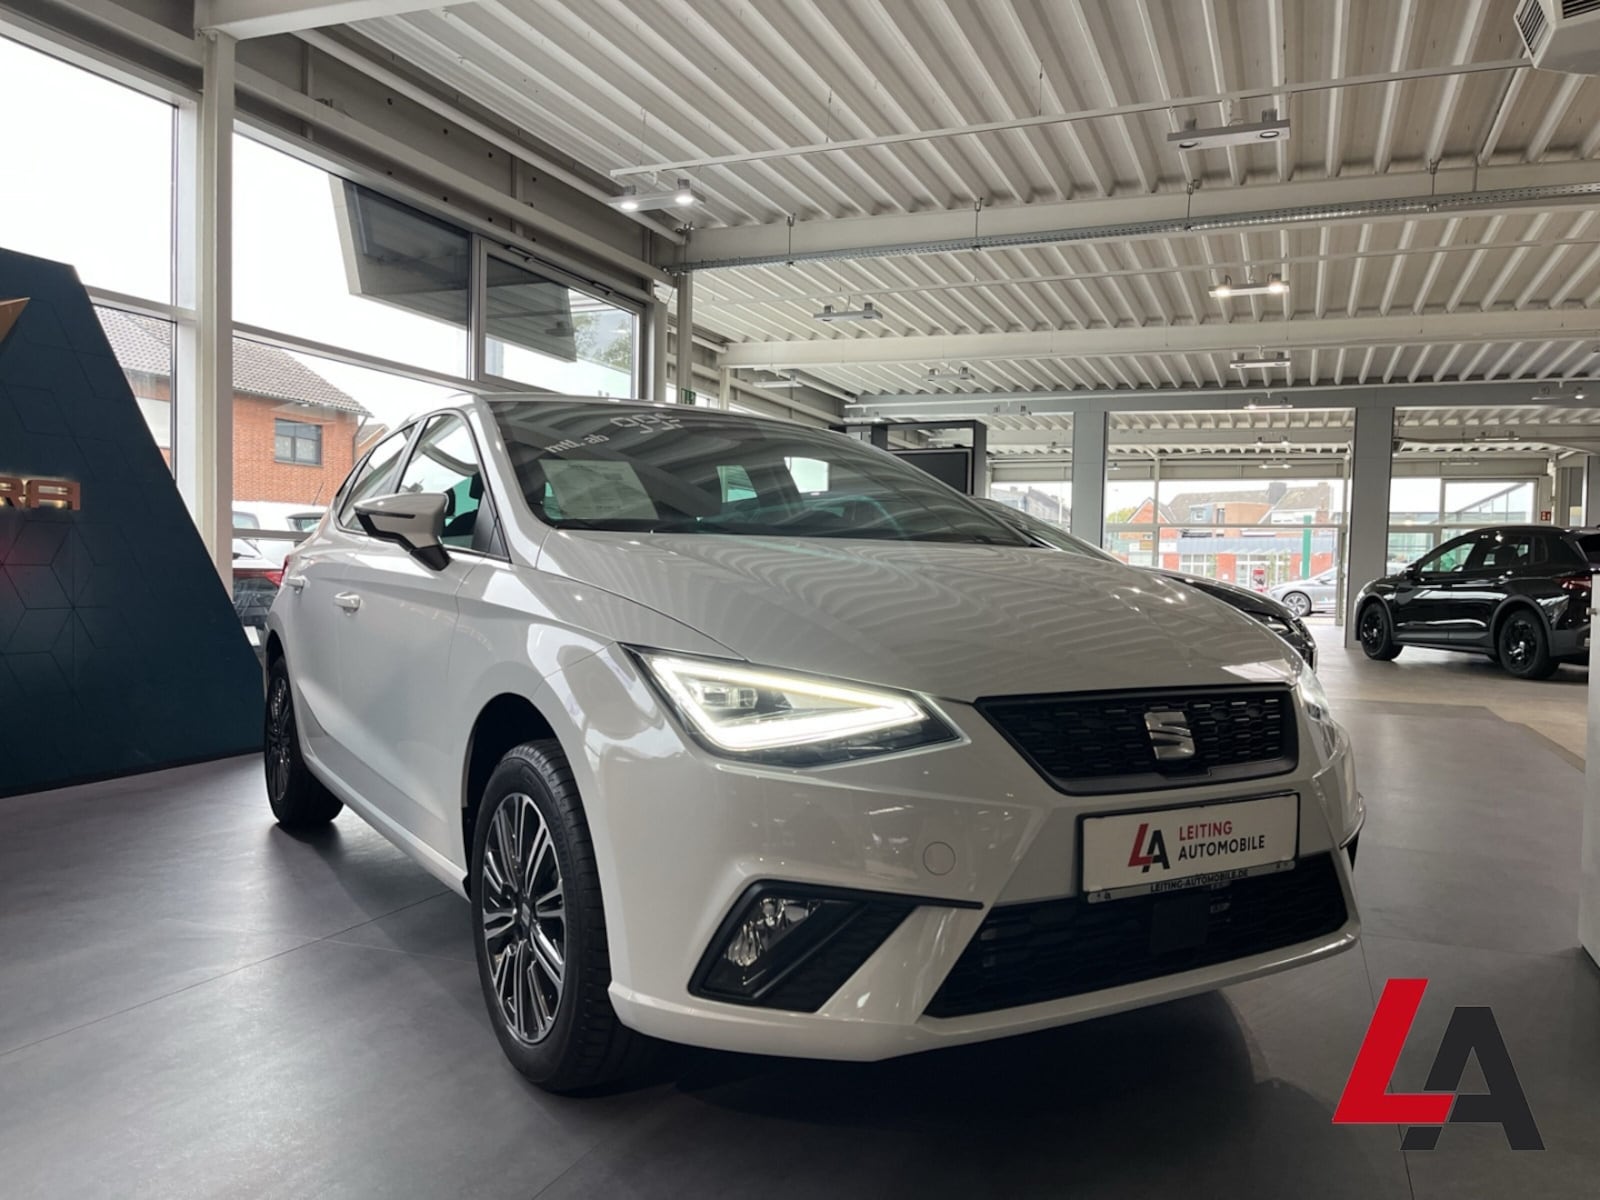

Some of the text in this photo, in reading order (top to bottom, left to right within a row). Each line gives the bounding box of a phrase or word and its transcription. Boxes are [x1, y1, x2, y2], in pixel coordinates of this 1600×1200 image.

[583, 434, 610, 444] ab
[1178, 821, 1233, 841] LEITING
[1178, 835, 1265, 861] AUTOMOBILE
[1150, 869, 1249, 892] LEITING-AUTOMOBILE.DE
